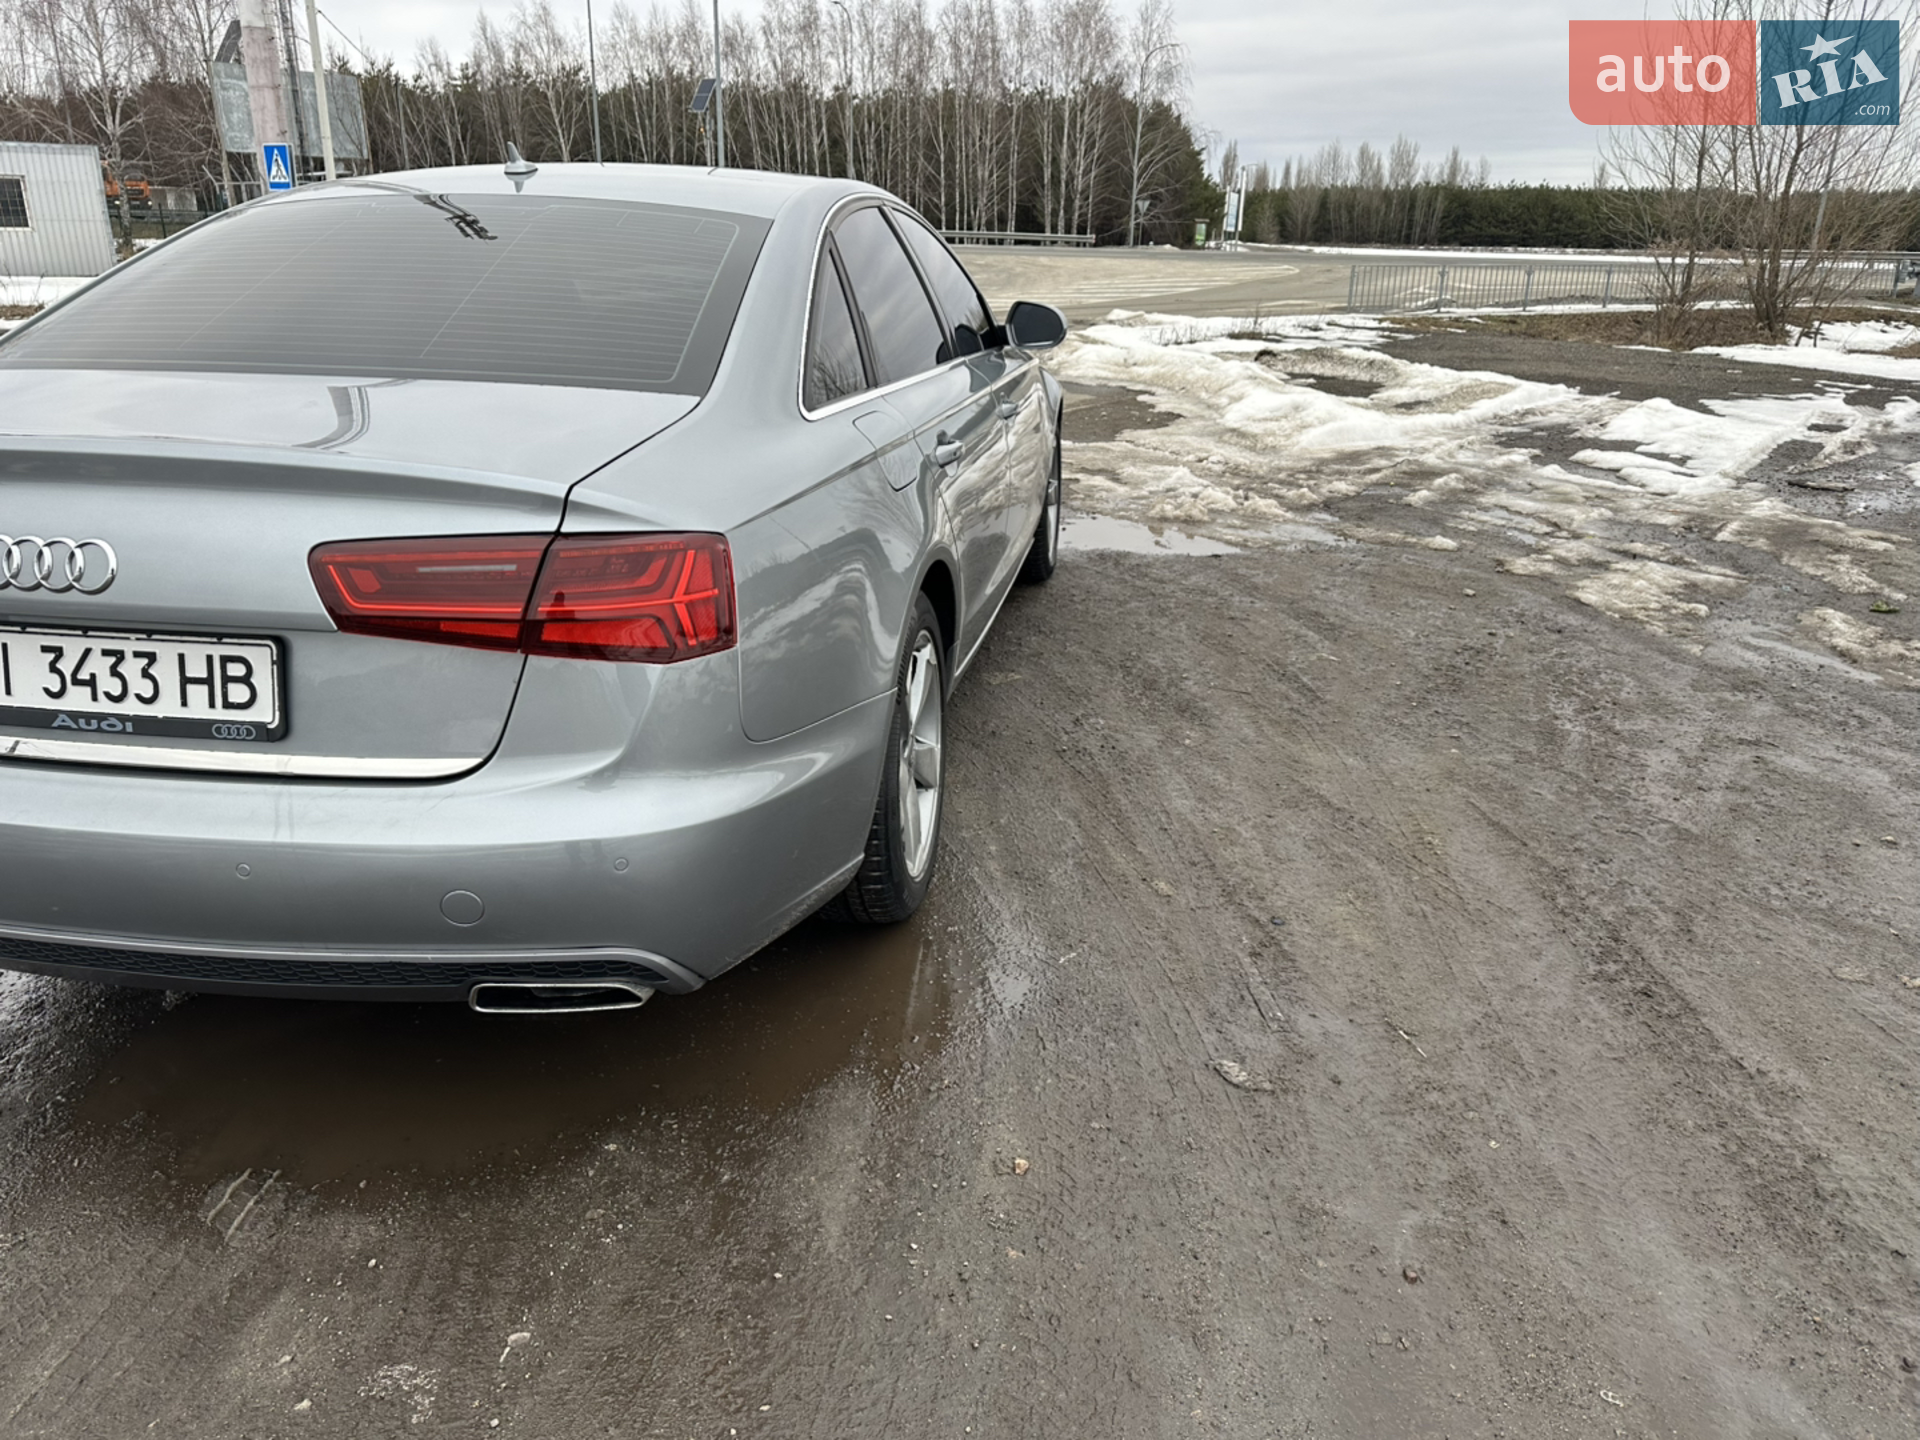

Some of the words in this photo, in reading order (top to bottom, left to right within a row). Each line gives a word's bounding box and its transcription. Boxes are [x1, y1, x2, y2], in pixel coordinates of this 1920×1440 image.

[40, 644, 160, 705] 3433
[177, 652, 258, 710] HB
[51, 714, 134, 732] Audi
